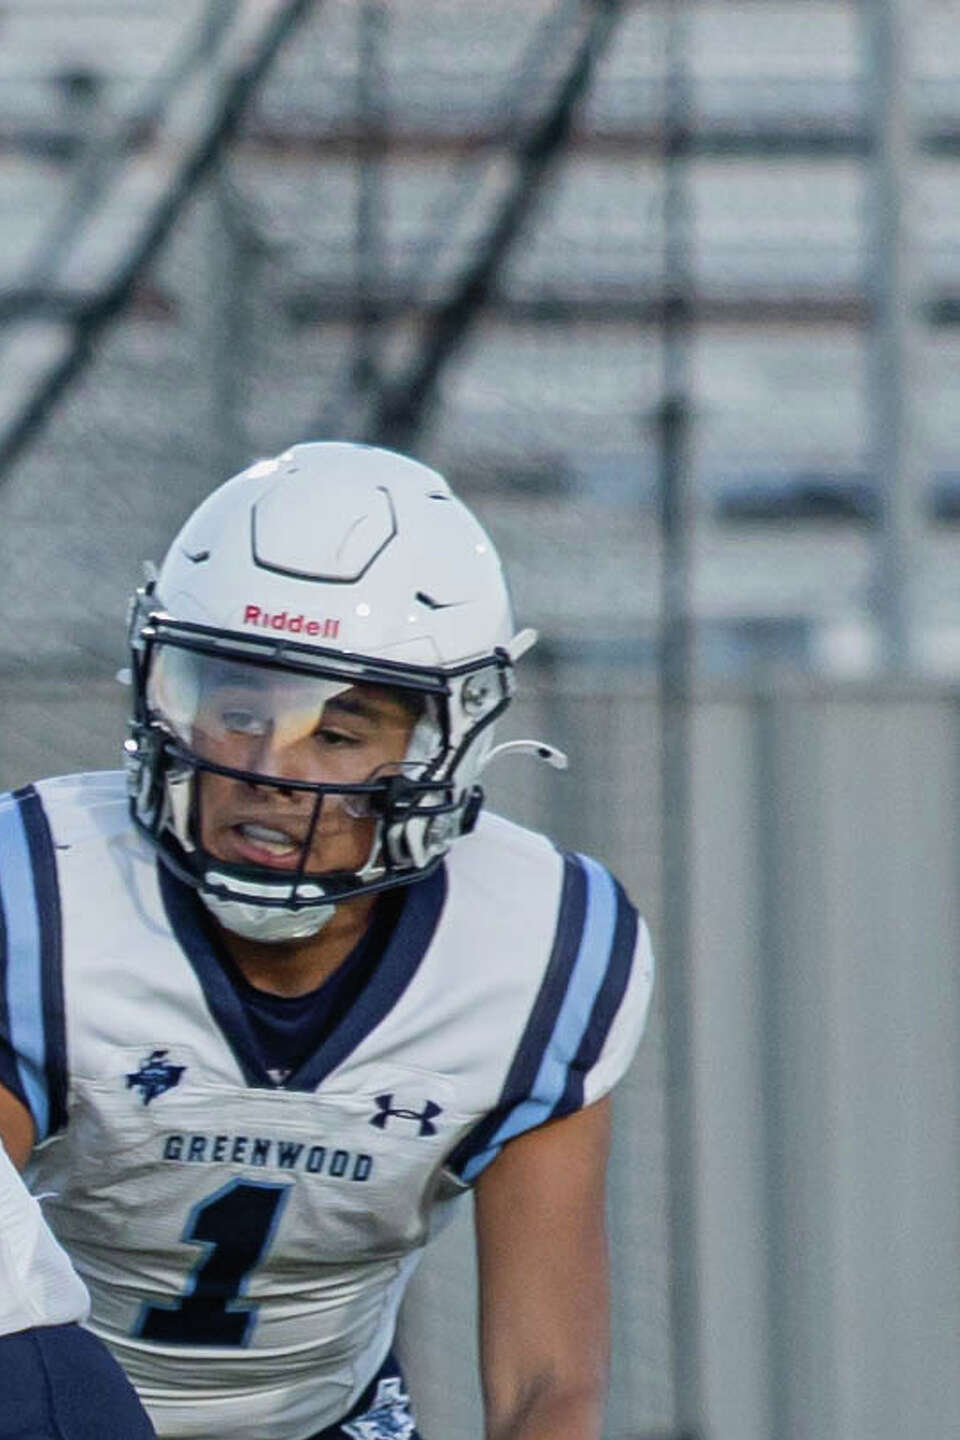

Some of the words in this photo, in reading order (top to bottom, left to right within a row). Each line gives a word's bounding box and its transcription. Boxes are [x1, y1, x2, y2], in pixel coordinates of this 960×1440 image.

[243, 605, 340, 639] Riddell
[163, 1135, 373, 1182] GREENWOOD
[131, 1175, 295, 1348] 1
